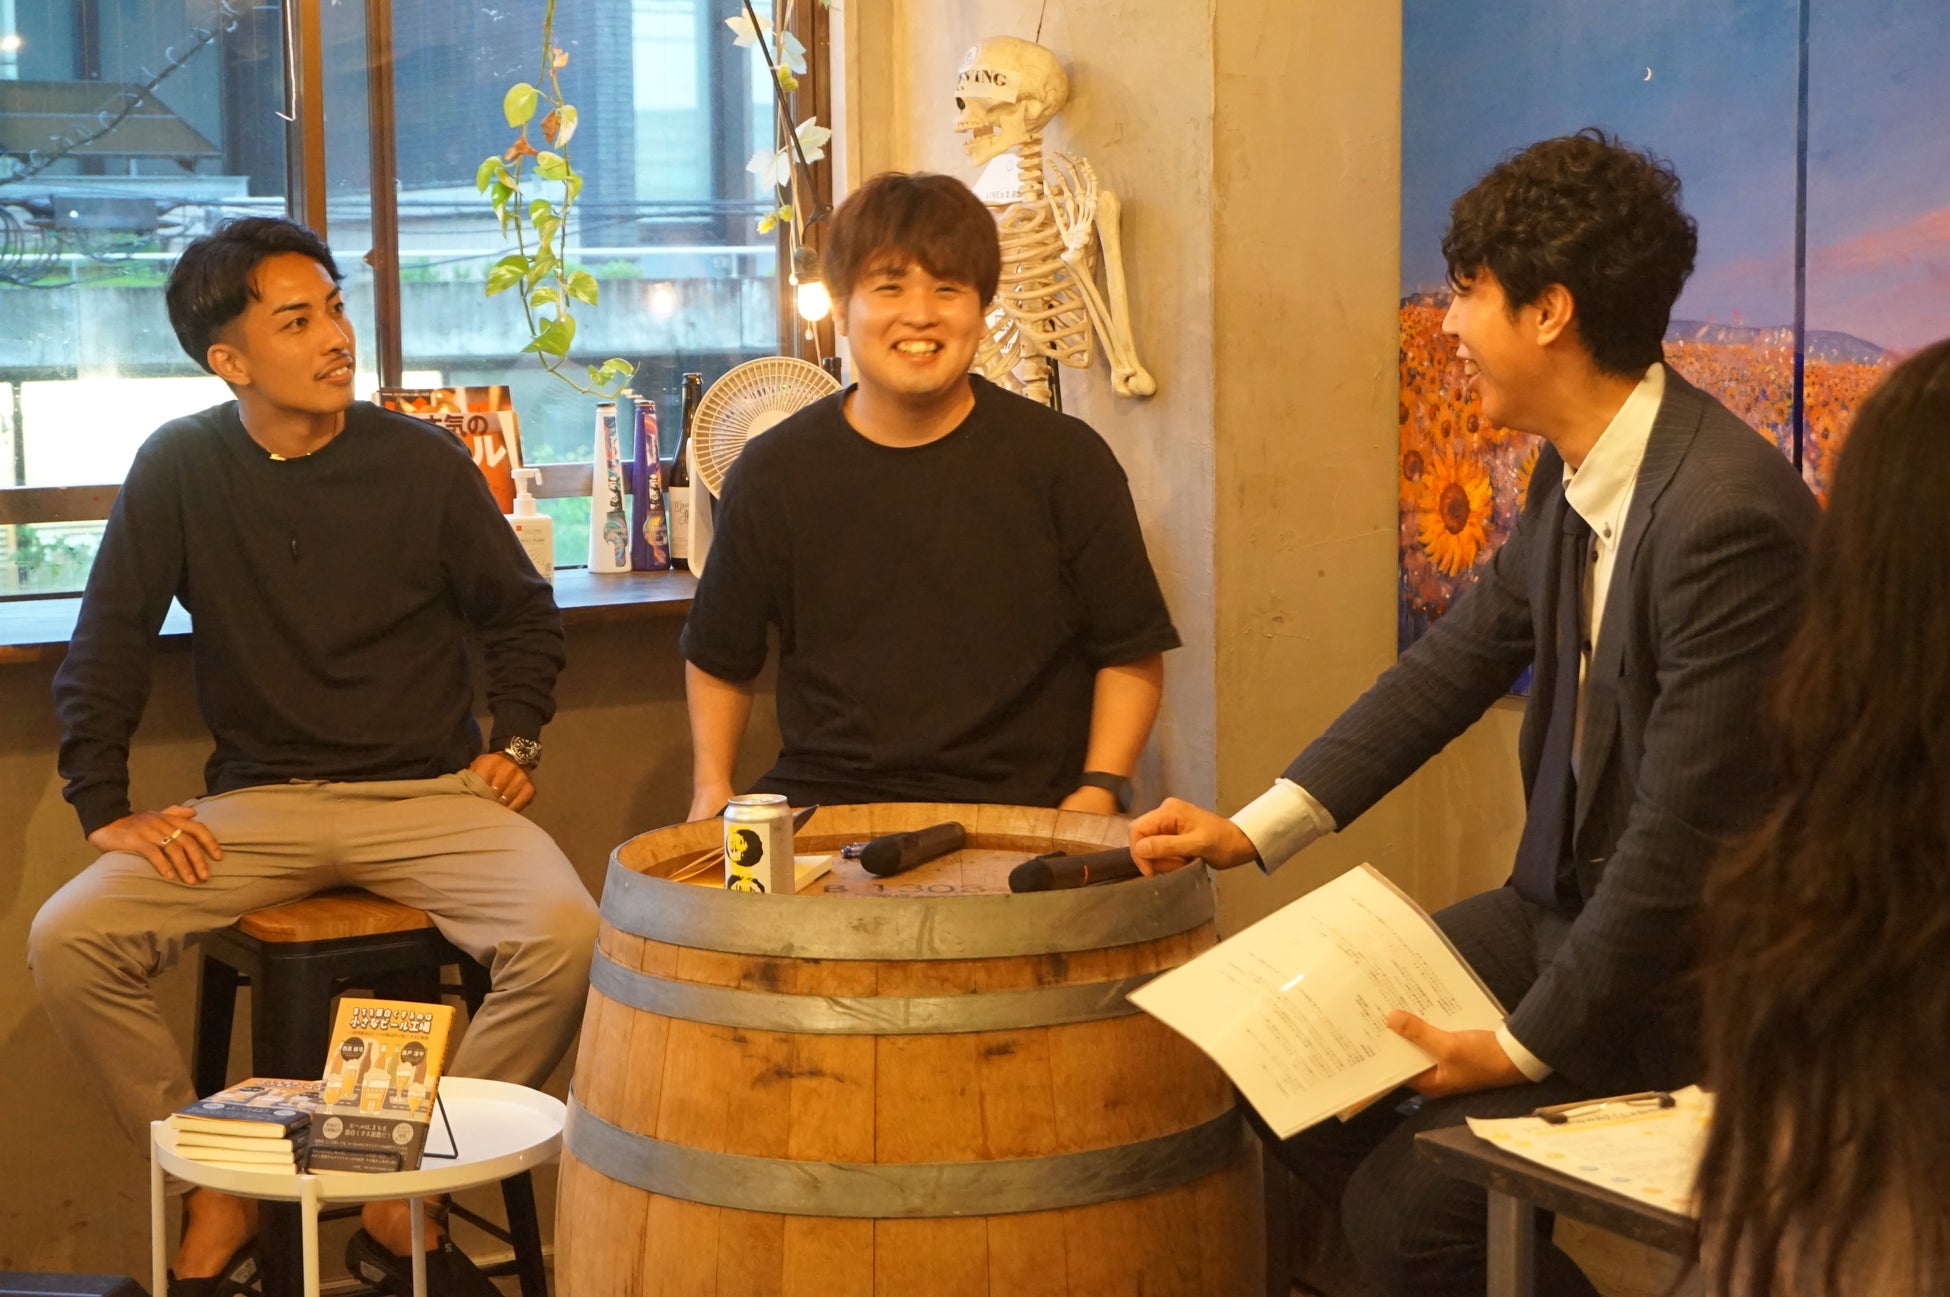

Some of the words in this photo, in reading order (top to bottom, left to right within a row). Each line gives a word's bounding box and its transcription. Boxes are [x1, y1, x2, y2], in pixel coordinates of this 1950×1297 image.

[426, 414, 489, 437] 気の
[350, 1016, 432, 1034] 小さなビール工場
